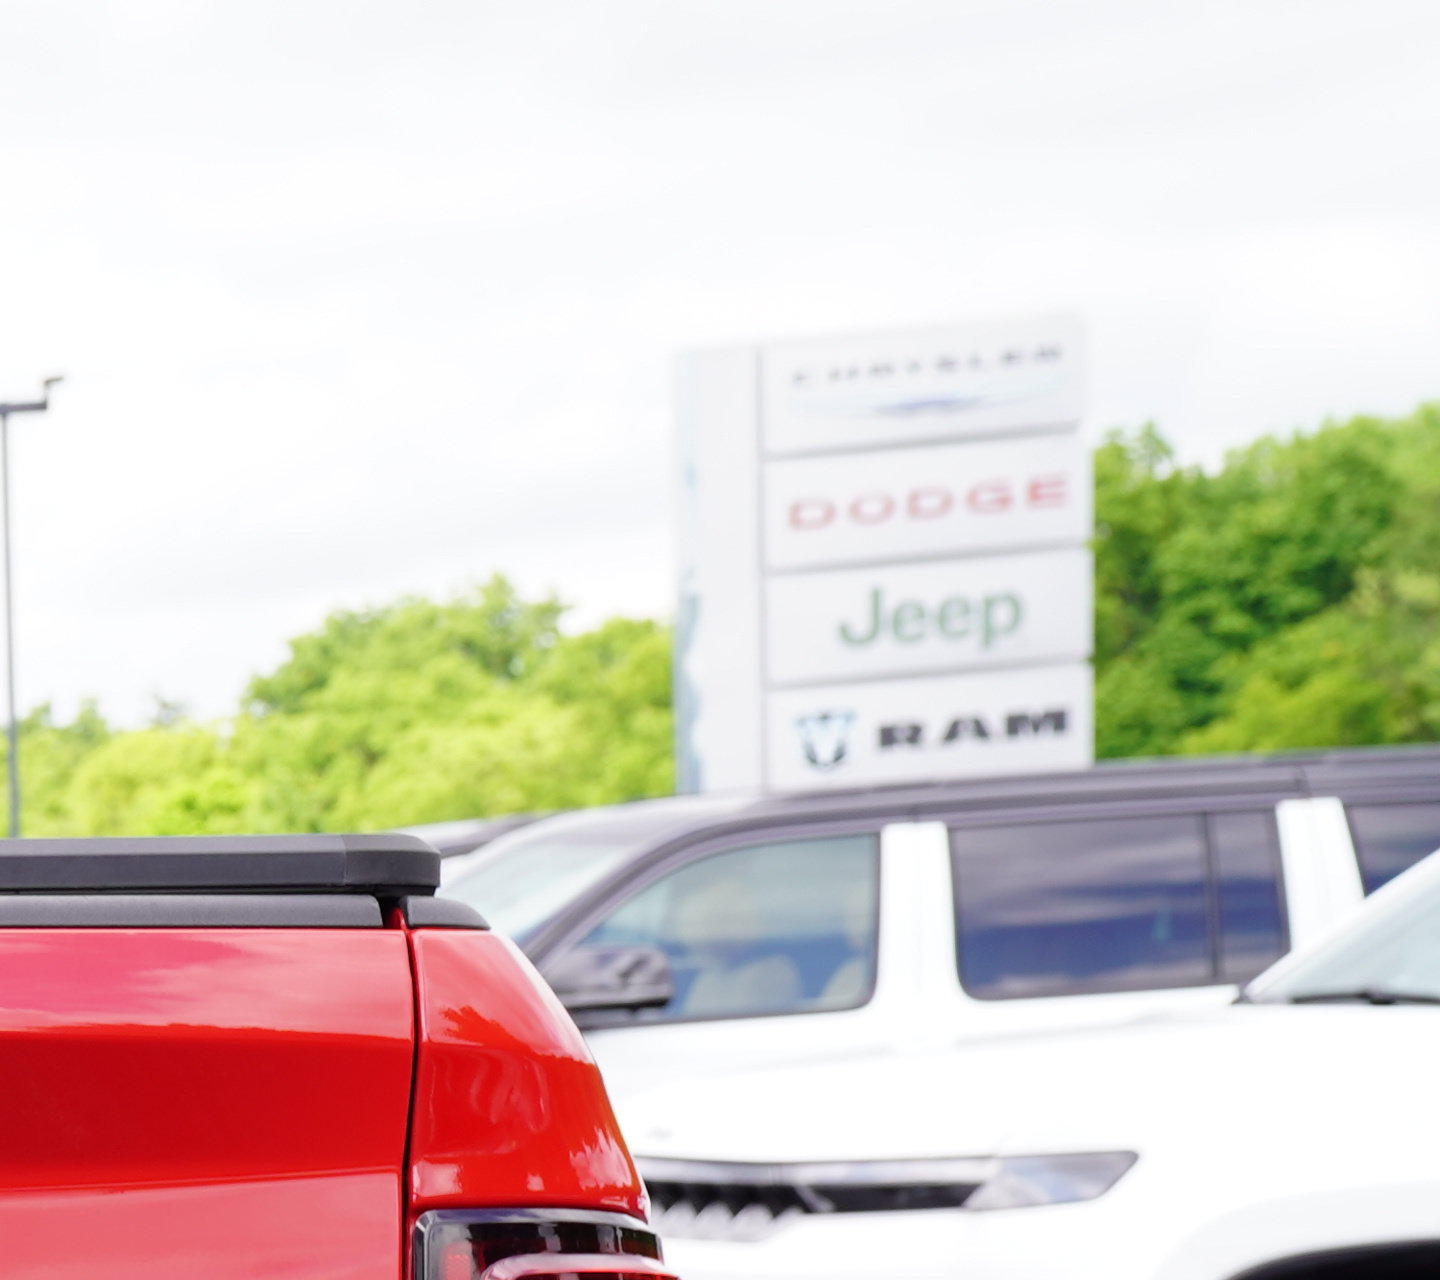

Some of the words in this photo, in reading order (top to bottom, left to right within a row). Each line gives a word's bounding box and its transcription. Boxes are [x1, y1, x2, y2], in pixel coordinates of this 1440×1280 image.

[789, 474, 1070, 531] DODGE
[838, 585, 1025, 651] Jeep
[879, 708, 1070, 749] RAM
